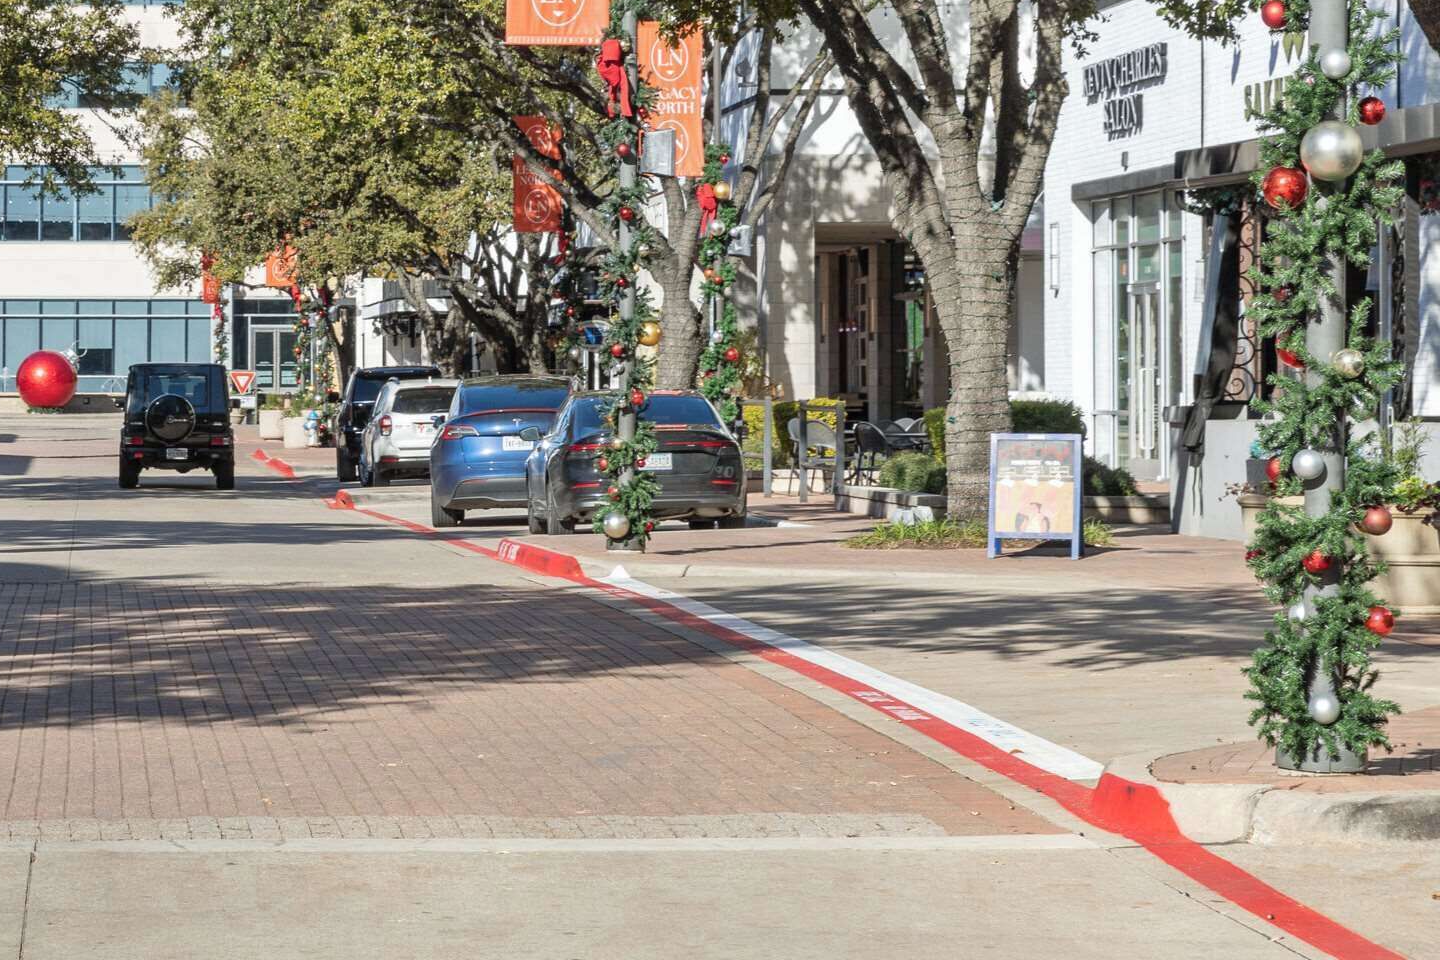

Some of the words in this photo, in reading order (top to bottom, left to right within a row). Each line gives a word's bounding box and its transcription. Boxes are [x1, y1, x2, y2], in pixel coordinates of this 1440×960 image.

[658, 49, 682, 66] LN
[1082, 58, 1113, 97] KEVIN
[1112, 42, 1163, 88] CHARLES
[659, 88, 699, 101] GACY
[656, 101, 696, 115] ORTH
[1103, 94, 1138, 134] SALON
[528, 199, 548, 212] LN
